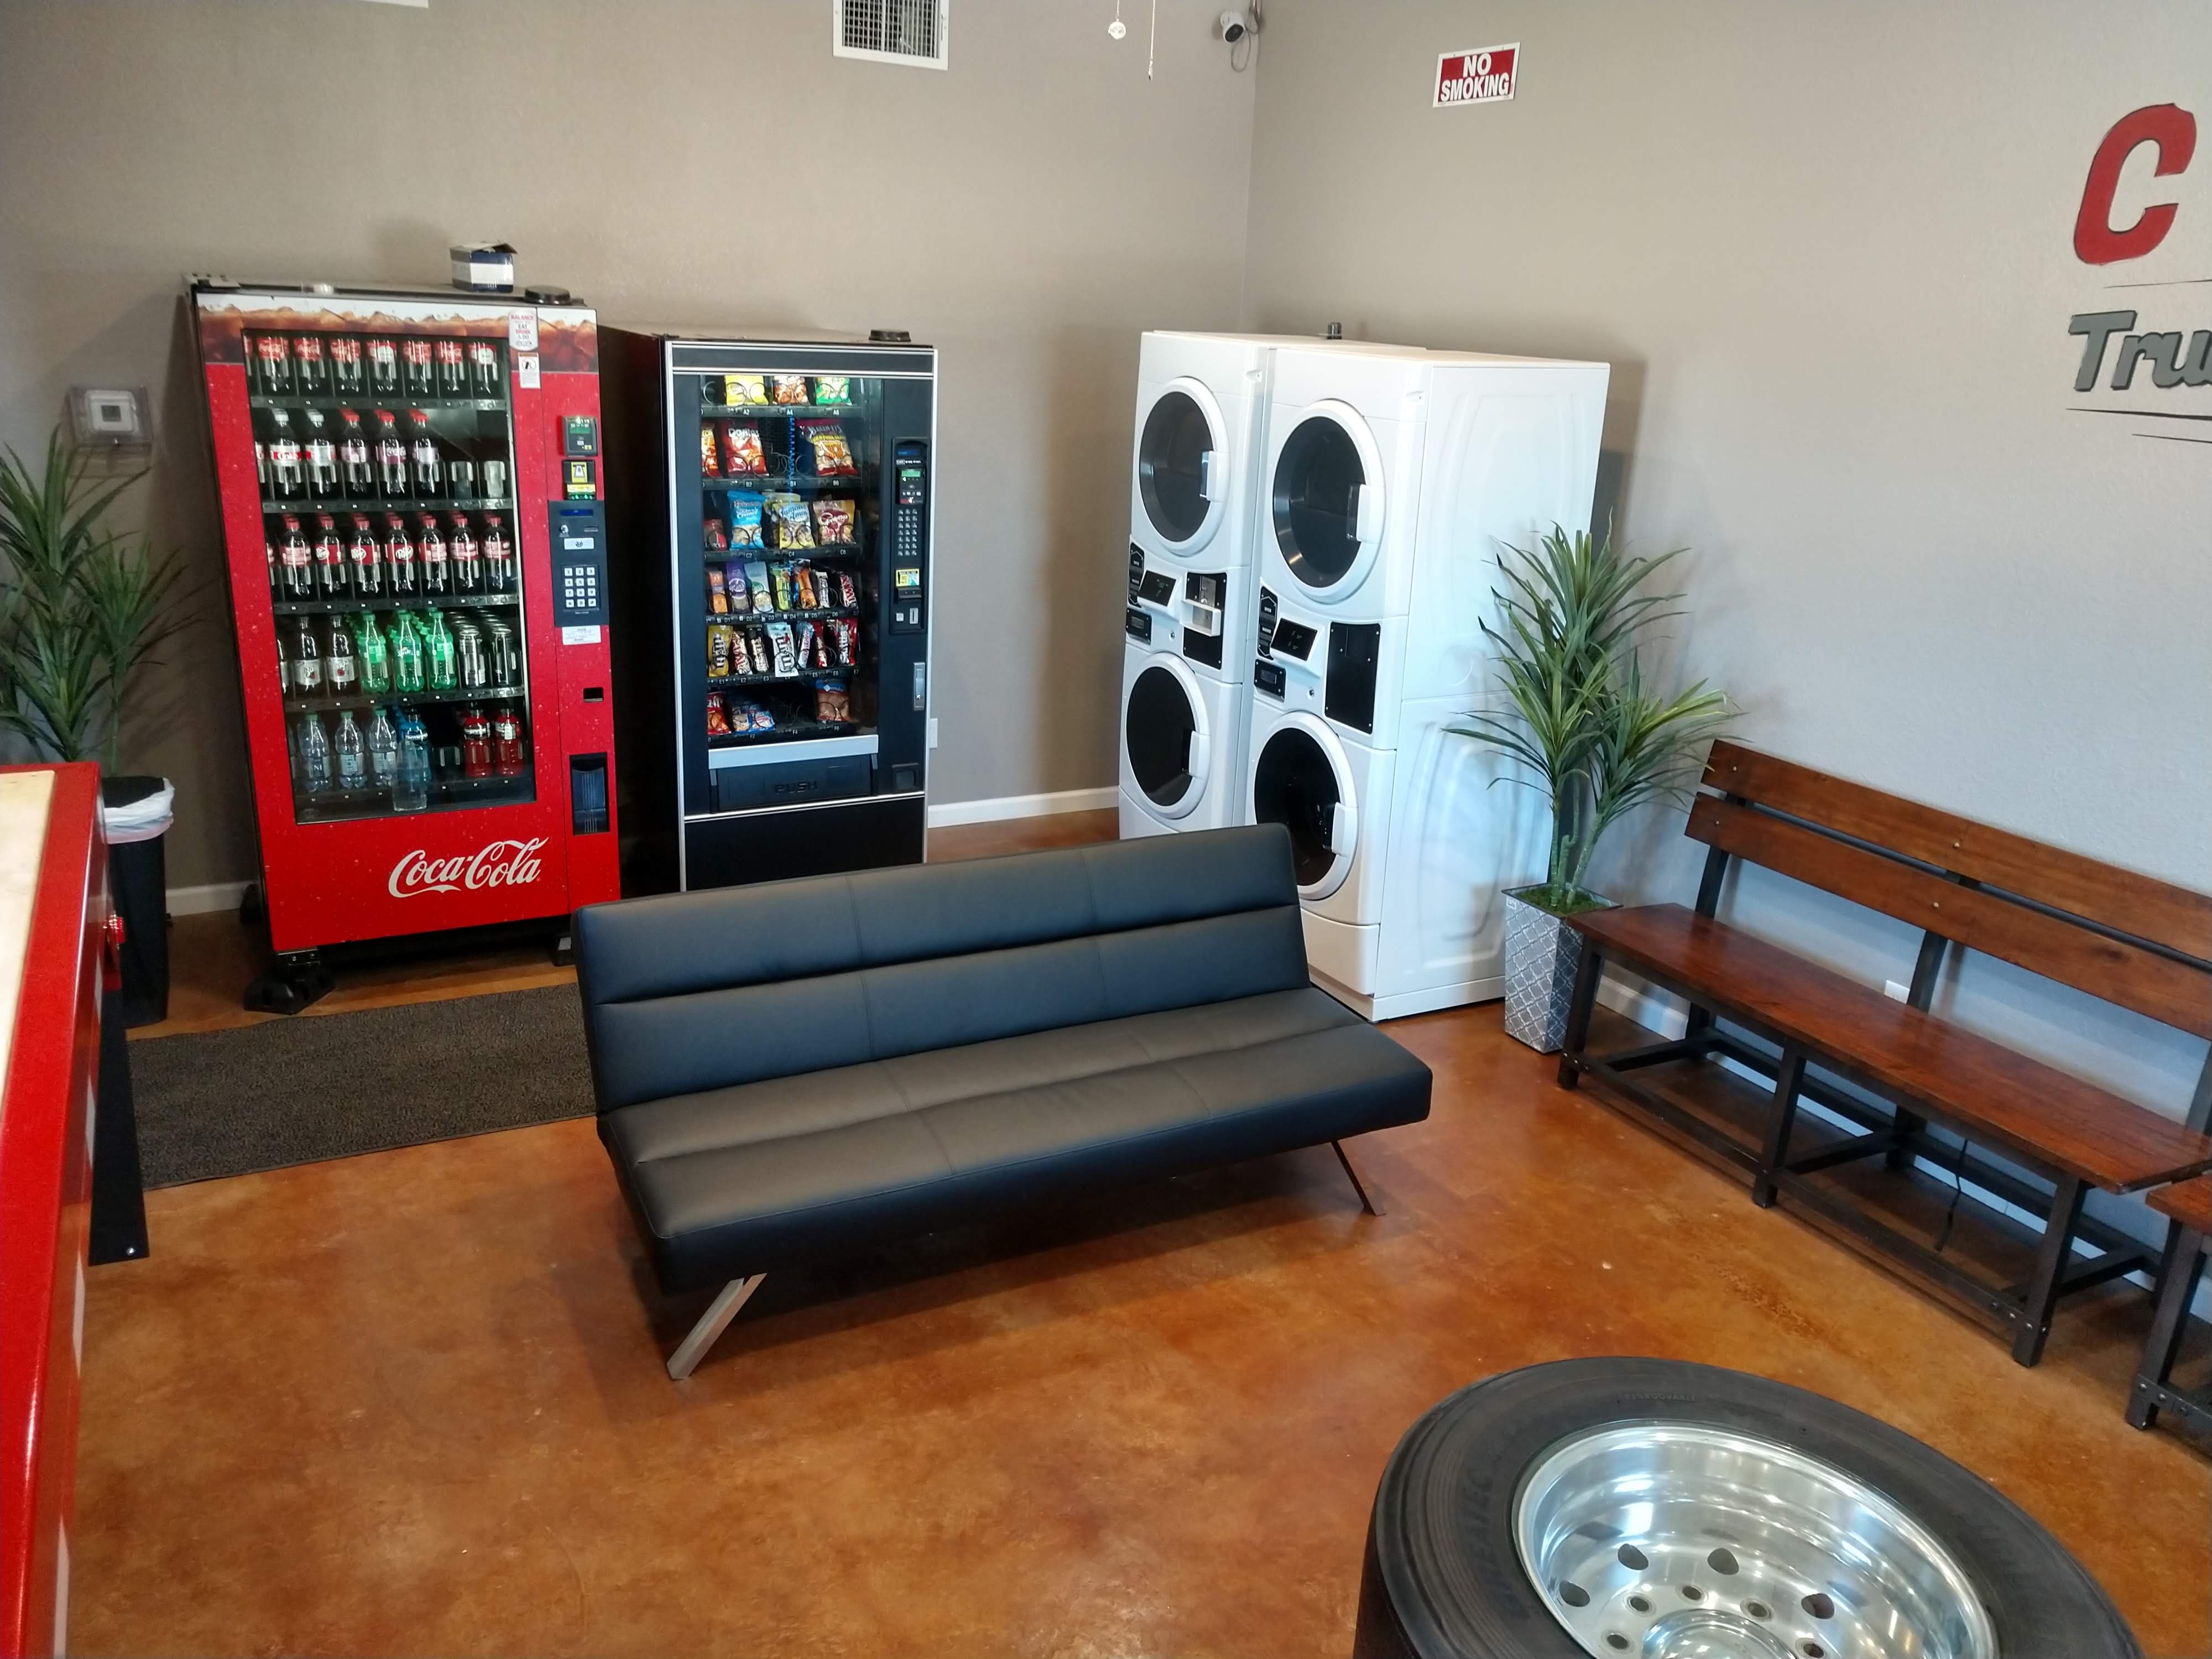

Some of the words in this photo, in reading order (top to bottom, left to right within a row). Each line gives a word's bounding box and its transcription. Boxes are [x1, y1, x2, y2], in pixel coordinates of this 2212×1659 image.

[1463, 53, 1492, 77] NO
[1440, 72, 1510, 101] SMOKING
[728, 429, 760, 439] Doritos
[775, 781, 817, 795] PUSH
[388, 837, 549, 898] Coca-Cola
